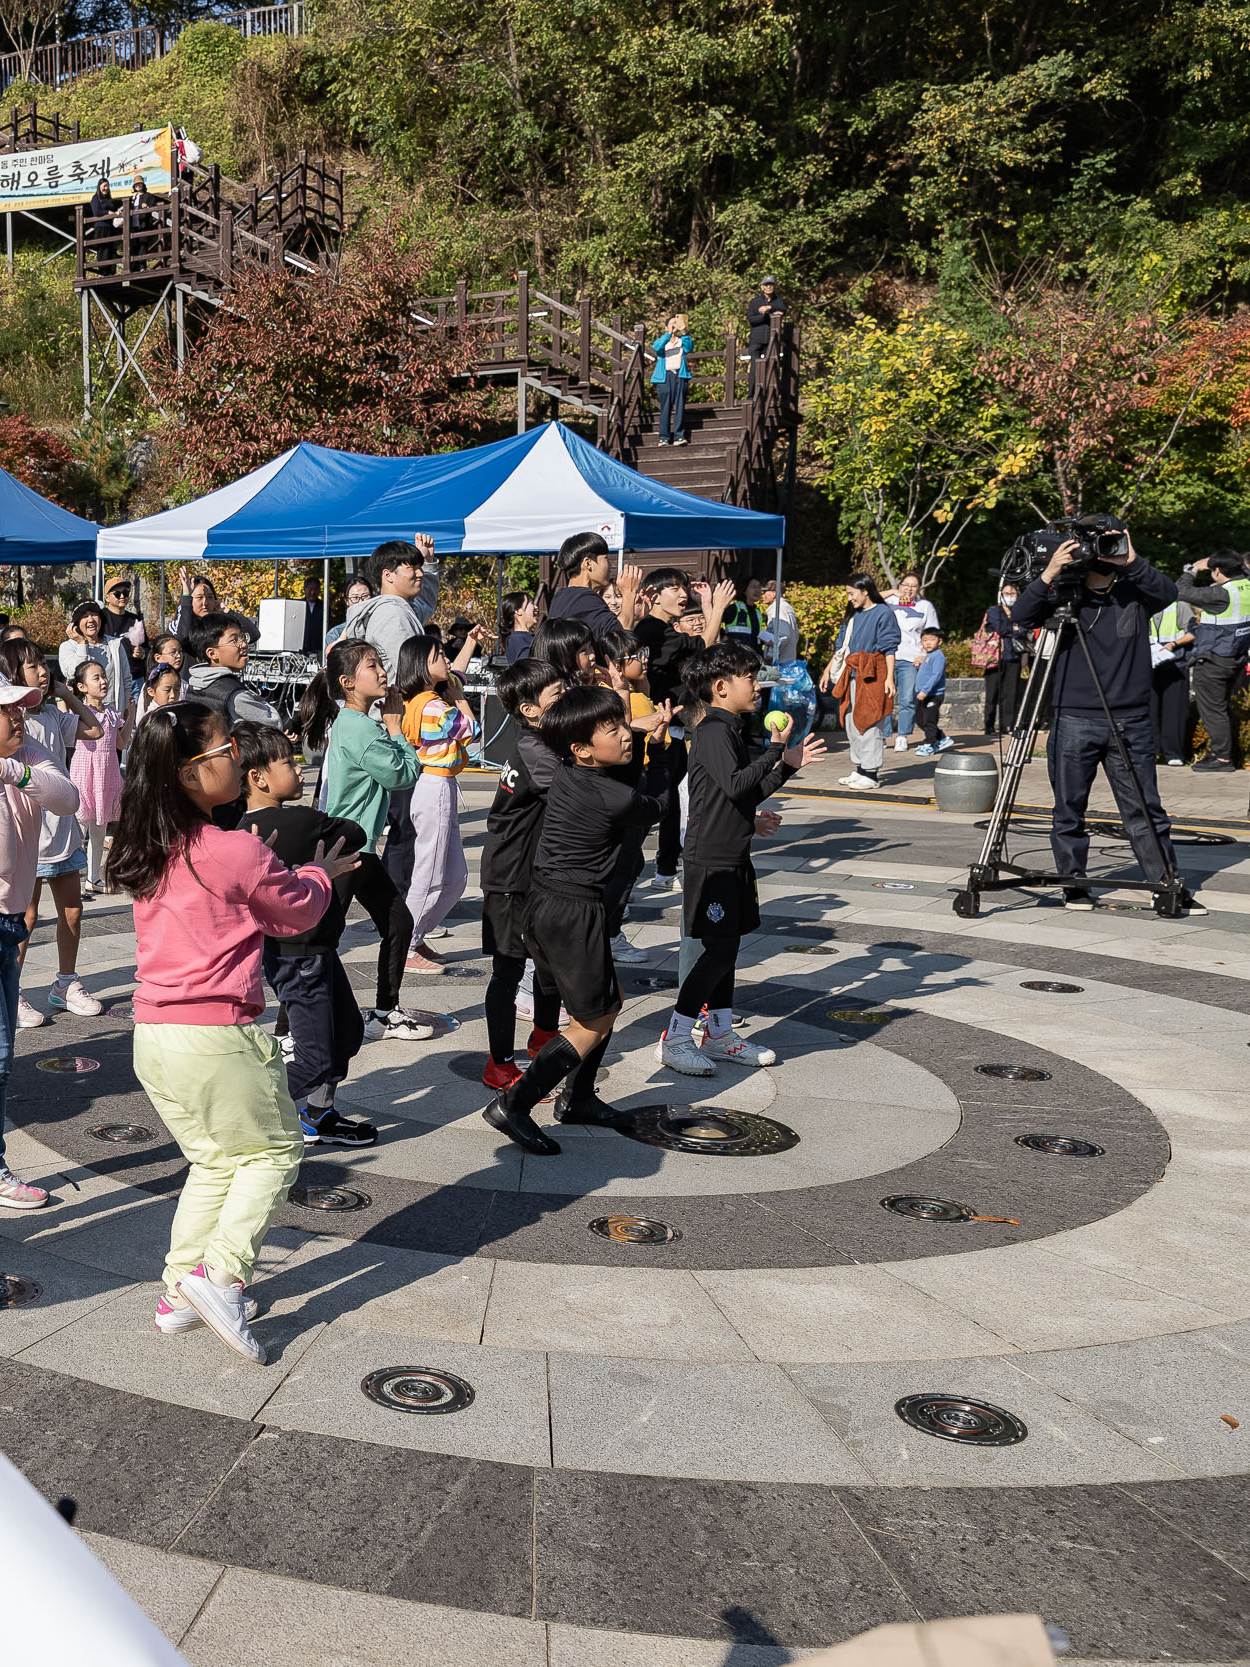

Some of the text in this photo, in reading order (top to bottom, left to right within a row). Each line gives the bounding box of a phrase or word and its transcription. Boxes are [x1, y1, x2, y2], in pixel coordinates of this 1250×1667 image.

[12, 158, 27, 168] 주민
[30, 154, 54, 166] 한마당
[0, 164, 64, 191] 해오름
[68, 157, 111, 184] 축제
